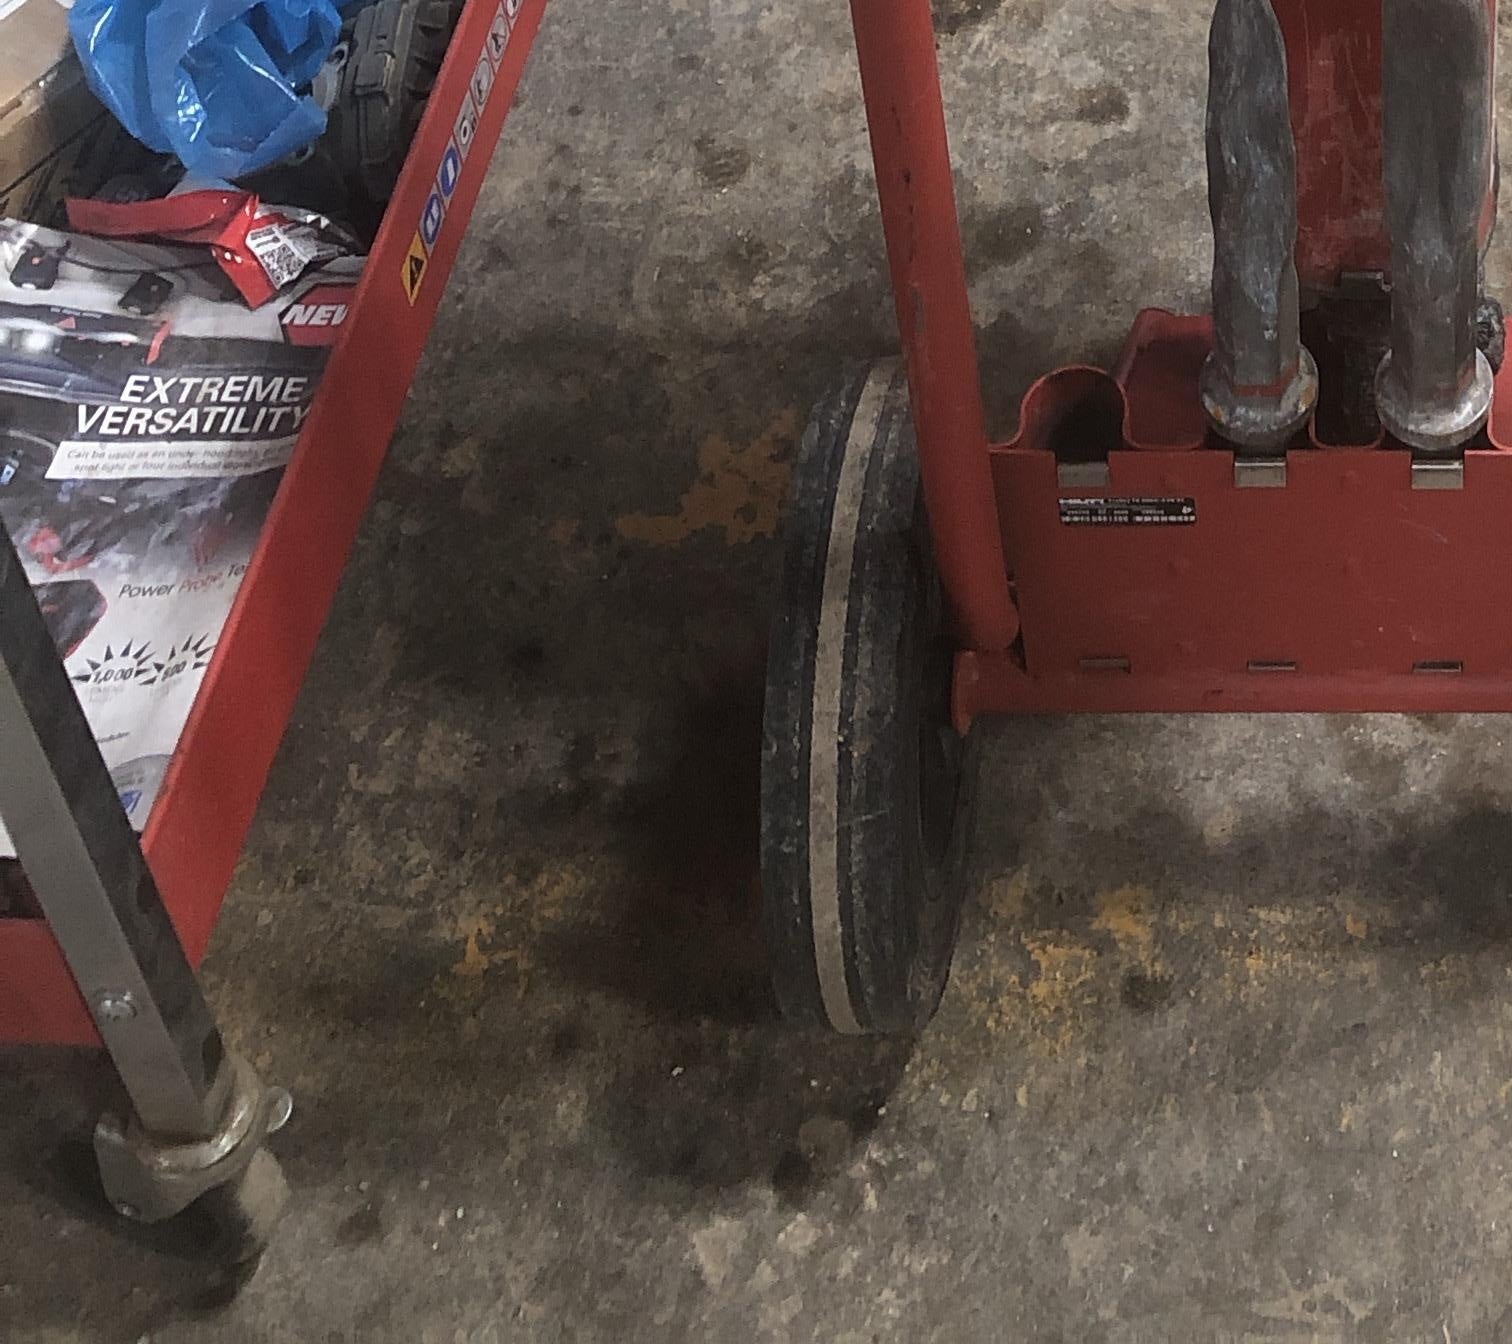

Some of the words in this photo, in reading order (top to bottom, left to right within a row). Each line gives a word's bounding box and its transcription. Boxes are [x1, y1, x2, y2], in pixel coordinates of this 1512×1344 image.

[120, 375, 308, 404] EXTREME
[77, 404, 311, 435] VERSATILITY
[119, 583, 176, 599] Power
